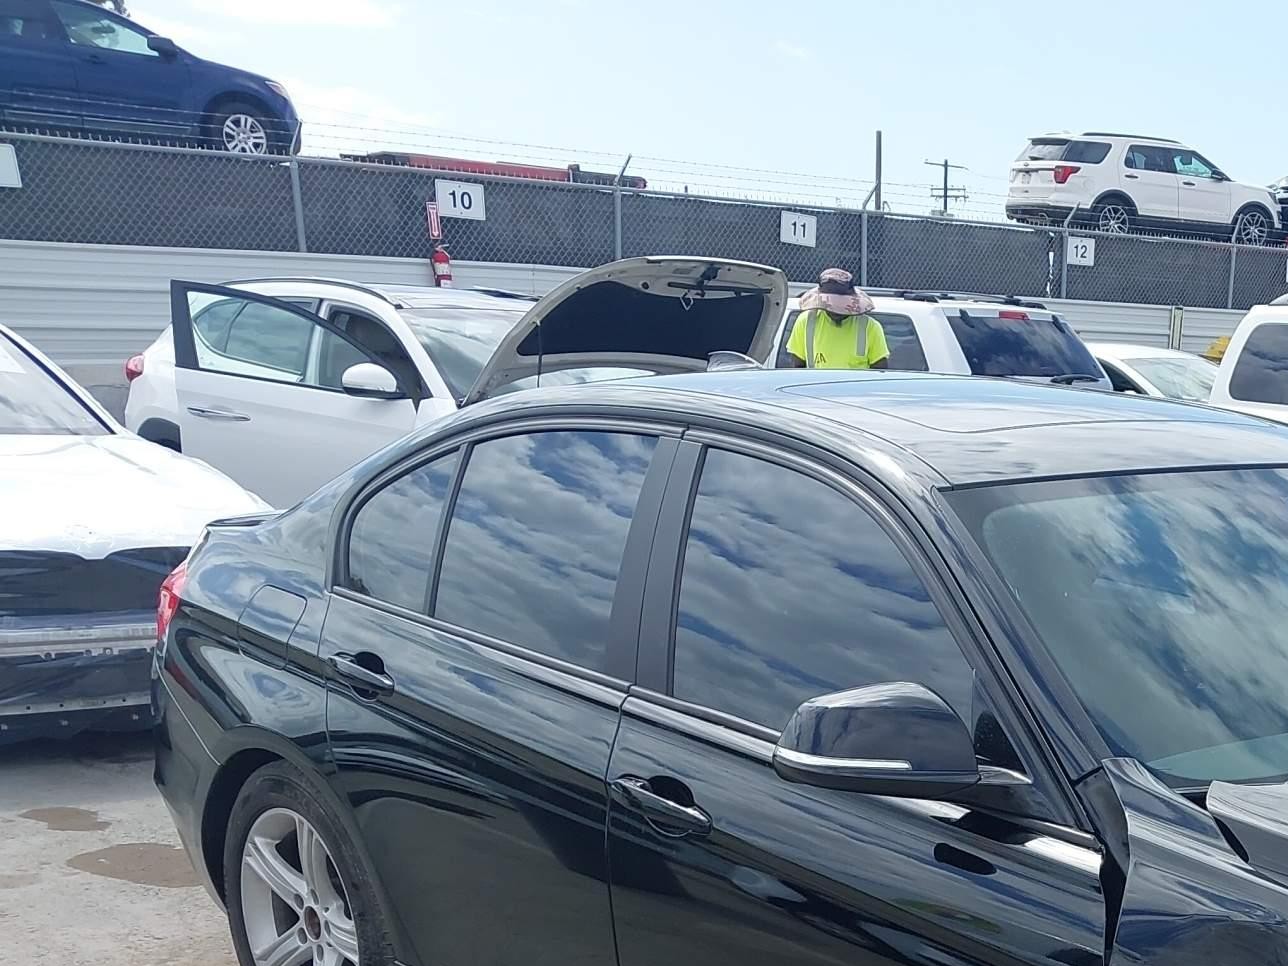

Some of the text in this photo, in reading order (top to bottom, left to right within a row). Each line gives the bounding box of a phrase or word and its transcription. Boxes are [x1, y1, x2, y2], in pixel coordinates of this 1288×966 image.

[448, 190, 473, 210] 10
[791, 221, 807, 239] 11
[1073, 244, 1088, 259] 12
